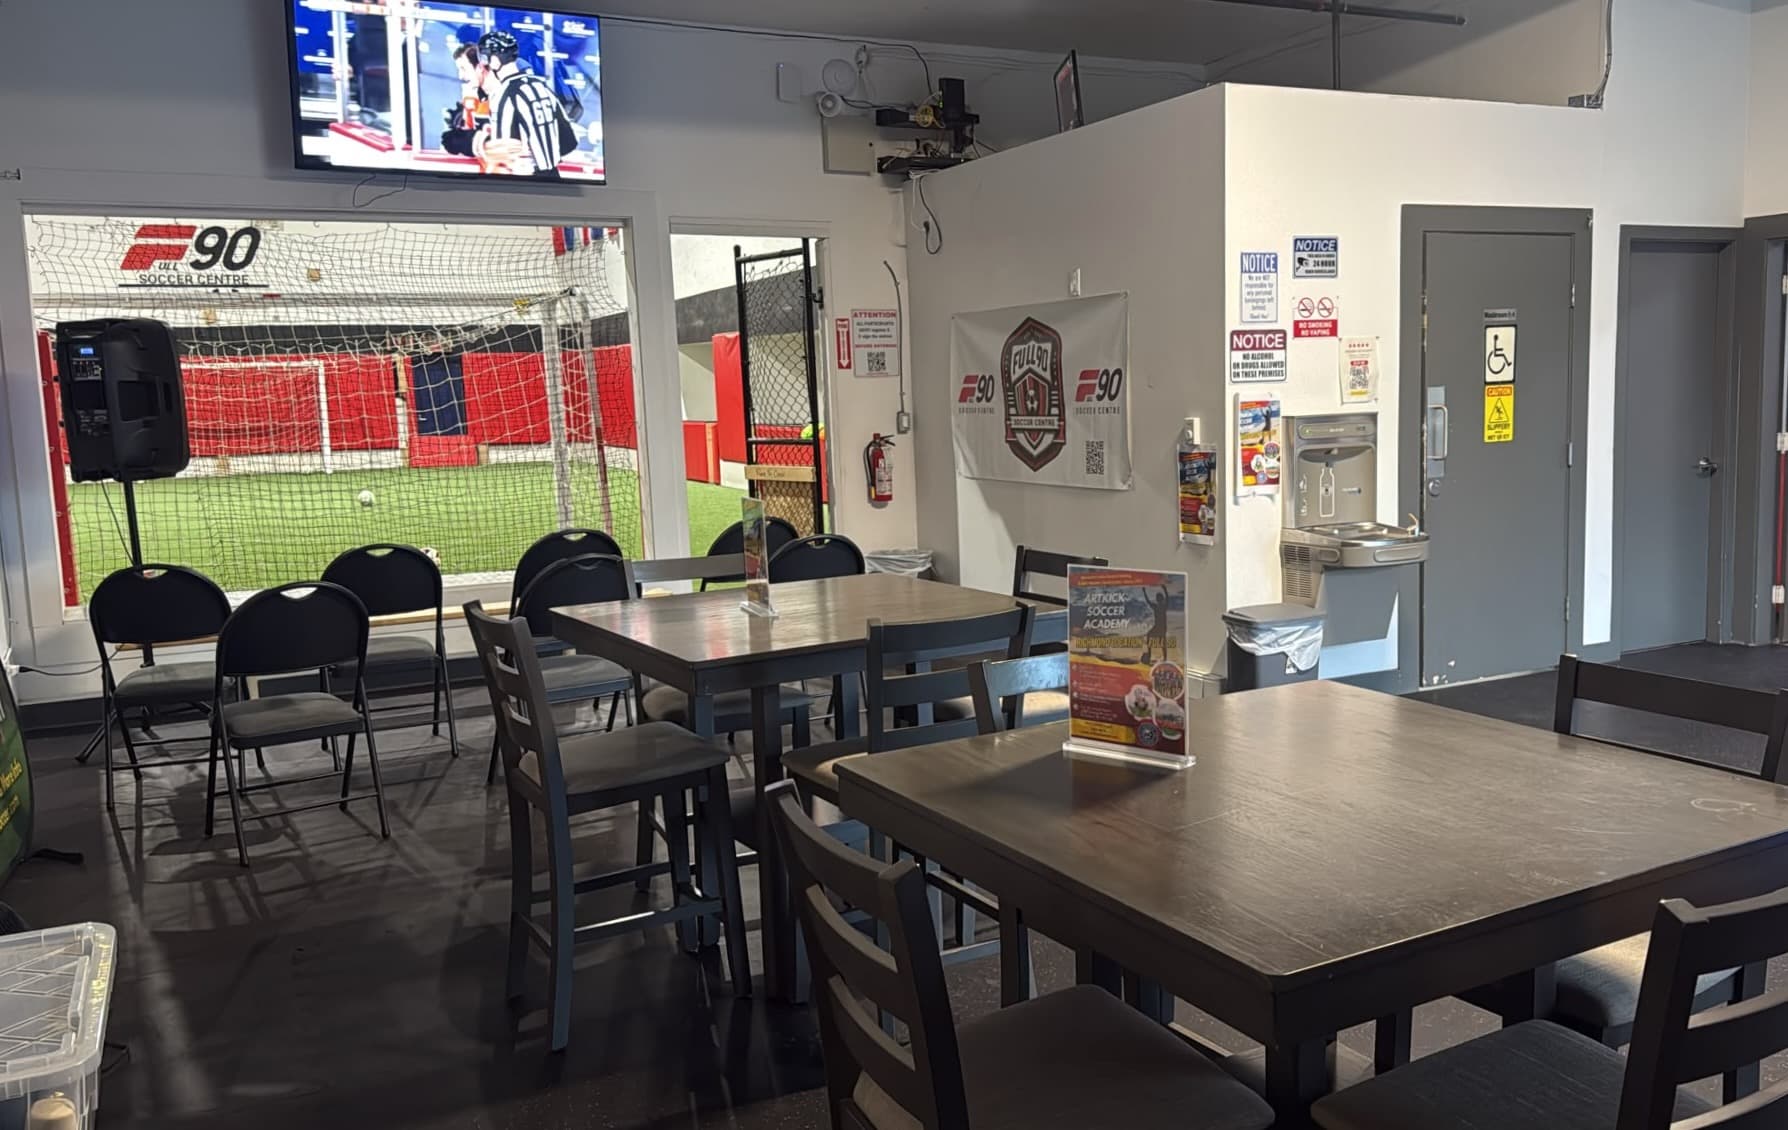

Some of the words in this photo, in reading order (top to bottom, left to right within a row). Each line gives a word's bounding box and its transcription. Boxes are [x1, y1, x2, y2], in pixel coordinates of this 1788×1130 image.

[533, 100, 553, 125] 66
[190, 226, 261, 271] 90
[1295, 240, 1335, 251] NOTICE
[1242, 254, 1276, 273] NOTICE
[139, 275, 193, 284] SOCCER
[197, 275, 249, 284] CENTRE
[1232, 334, 1284, 348] NOTICE
[1242, 352, 1250, 360] NO
[1251, 352, 1274, 360] ALCOHOL
[1233, 362, 1240, 370] OR
[1241, 370, 1257, 378] THESE
[1258, 369, 1284, 377] PREMISES
[976, 375, 995, 403] 90
[1096, 368, 1123, 402] 90
[1098, 406, 1121, 415] CENTRE
[1014, 419, 1033, 427] SOCCER
[1035, 418, 1056, 427] CENTRE
[1087, 606, 1125, 616] SOCCER
[1083, 619, 1130, 630] ACADEMY
